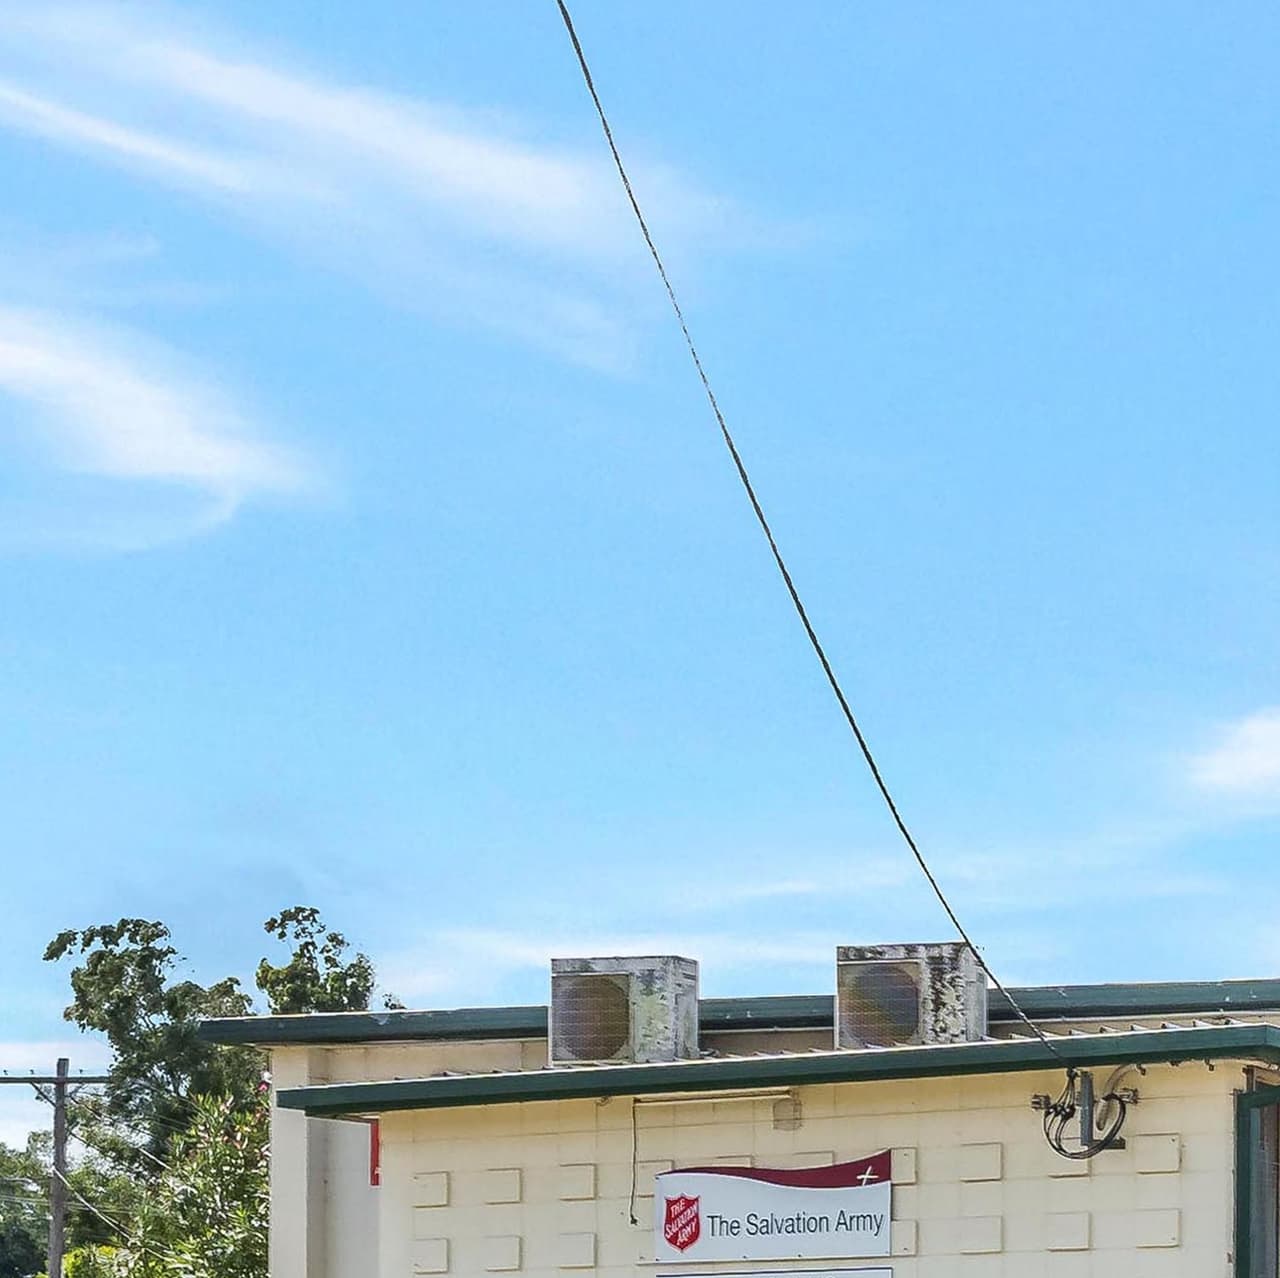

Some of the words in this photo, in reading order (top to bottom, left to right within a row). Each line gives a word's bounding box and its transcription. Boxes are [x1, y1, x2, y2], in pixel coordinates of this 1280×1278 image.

[706, 1214, 741, 1238] The
[745, 1211, 830, 1237] Salvation
[833, 1209, 885, 1238] Army
